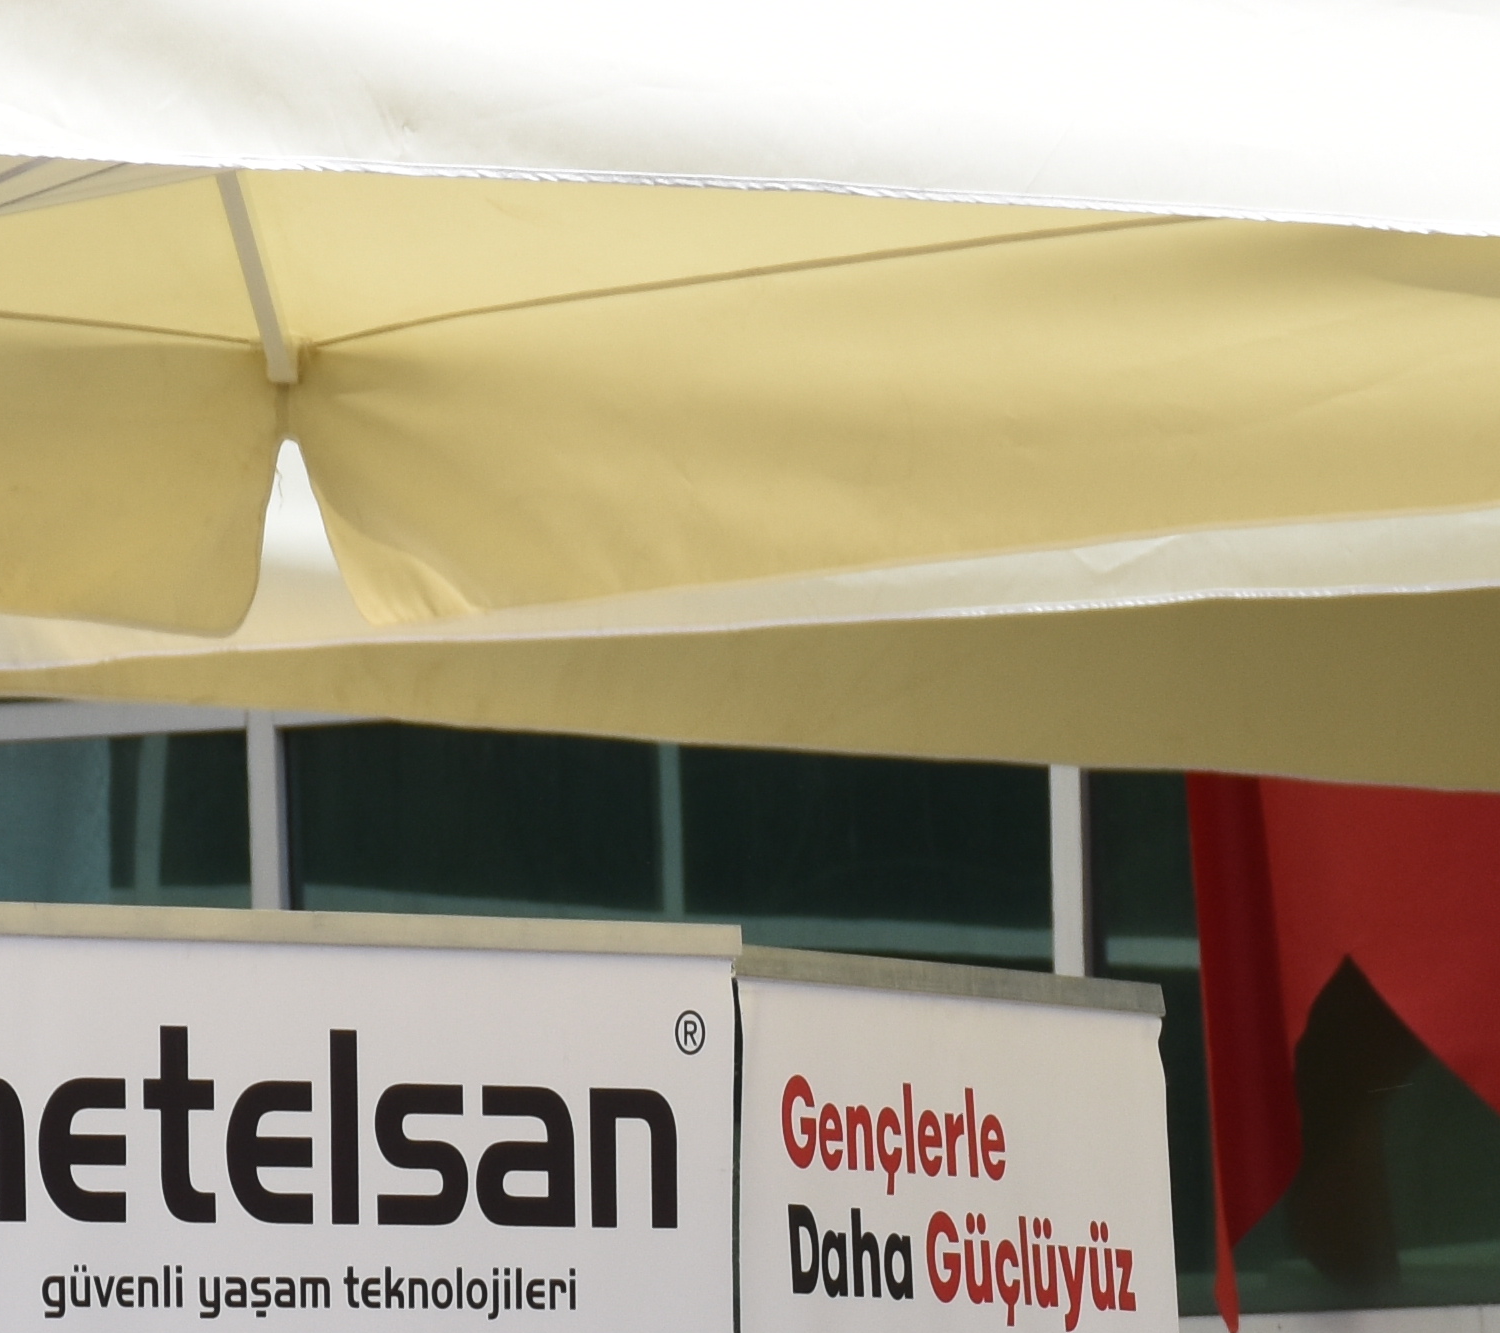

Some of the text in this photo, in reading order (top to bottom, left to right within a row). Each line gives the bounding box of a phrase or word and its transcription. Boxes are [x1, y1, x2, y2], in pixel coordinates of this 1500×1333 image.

[781, 1074, 1006, 1196] Gençlerle
[41, 1264, 577, 1321] güvenli yaşam teknolojileri
[787, 1203, 1137, 1333] Daha Güçlüyüz
